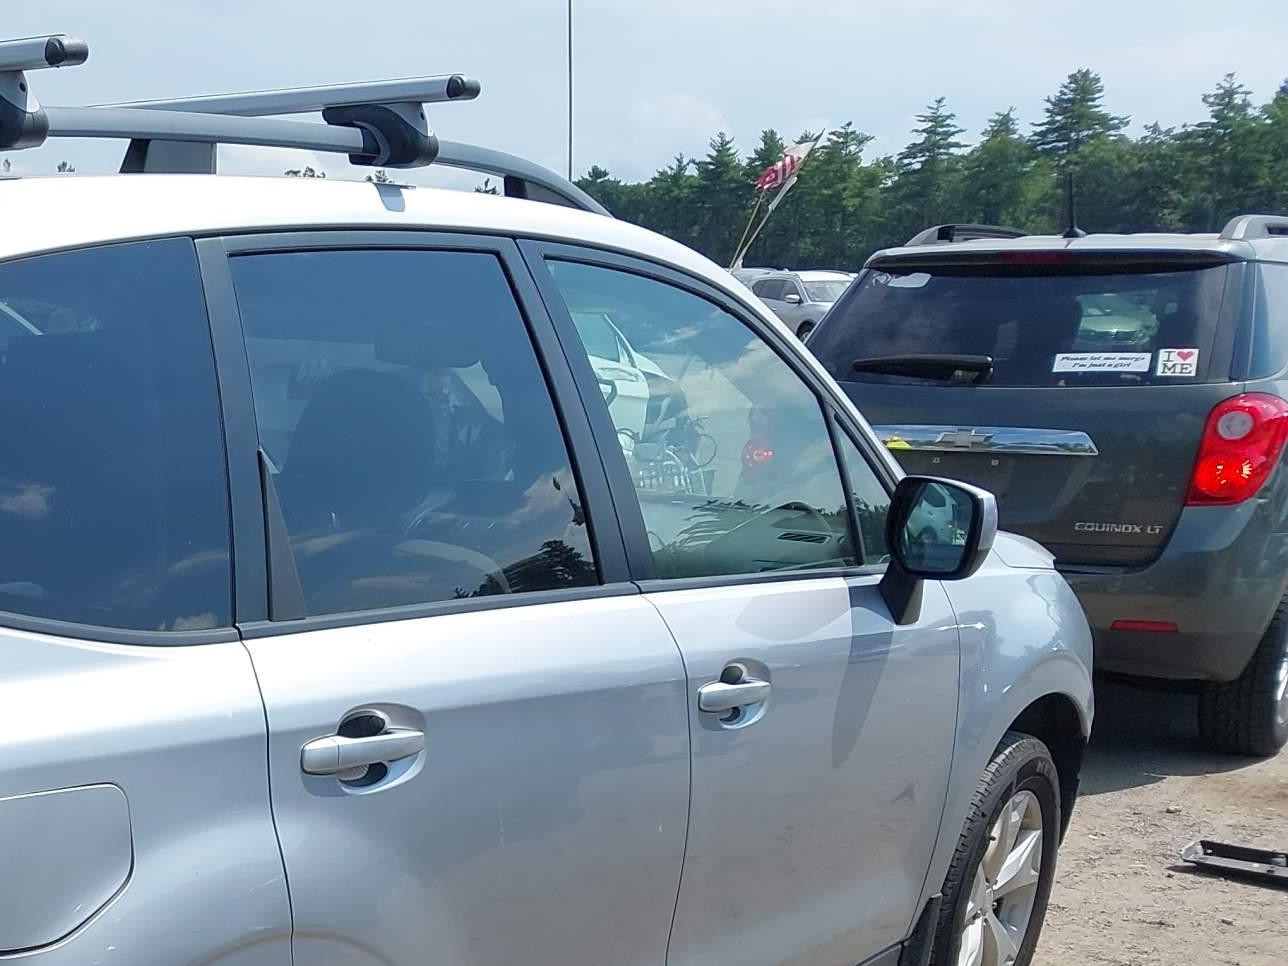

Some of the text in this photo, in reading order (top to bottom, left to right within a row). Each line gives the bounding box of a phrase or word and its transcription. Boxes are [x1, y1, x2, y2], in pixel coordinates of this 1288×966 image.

[1163, 351, 1176, 362] I
[1161, 363, 1193, 374] ME
[1074, 522, 1164, 534] EQUINOX LT
